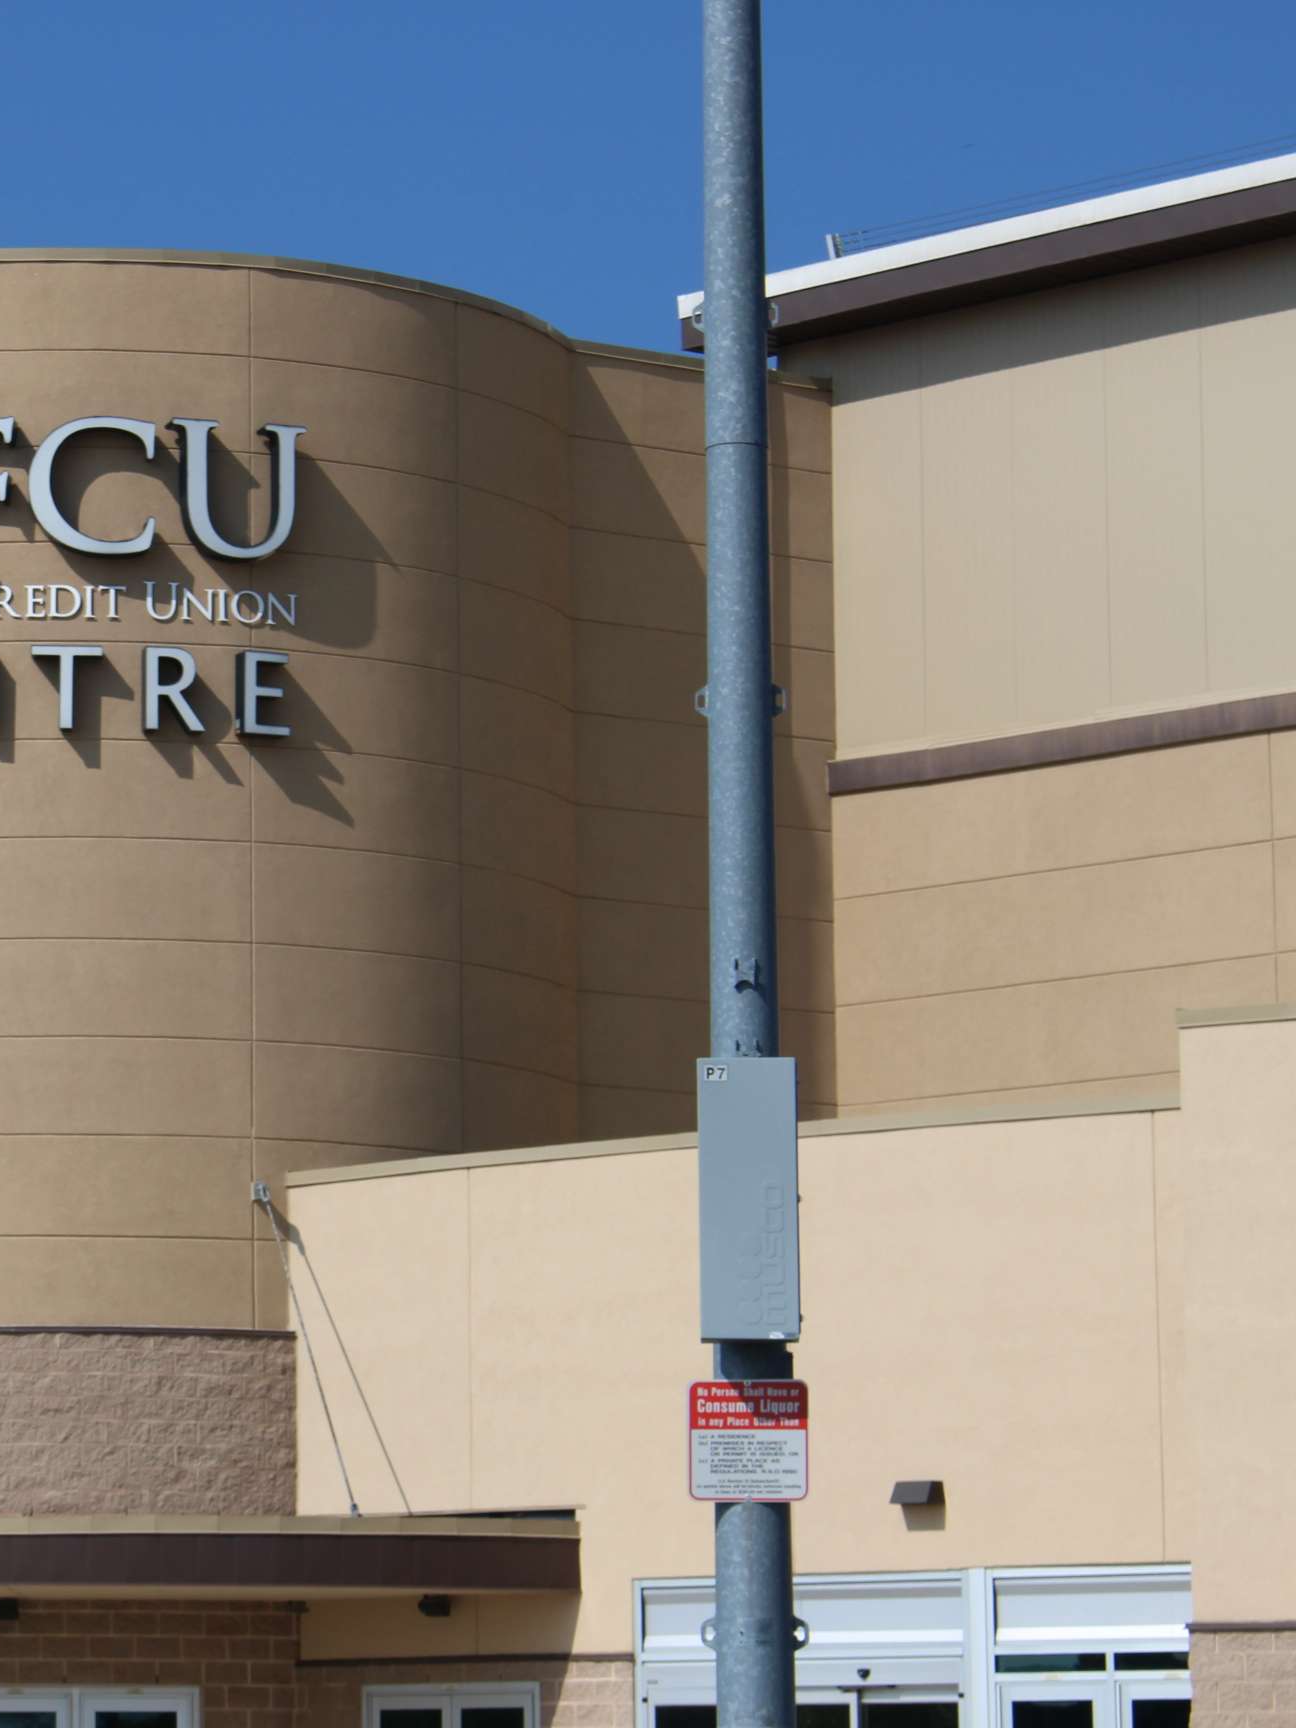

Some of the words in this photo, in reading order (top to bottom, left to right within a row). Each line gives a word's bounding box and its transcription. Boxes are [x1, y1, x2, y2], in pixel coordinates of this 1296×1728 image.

[144, 581, 298, 627] UNION
[697, 1399, 755, 1413] Consume
[760, 1399, 800, 1415] Liquor
[709, 1418, 724, 1428] any
[727, 1417, 749, 1426] Place
